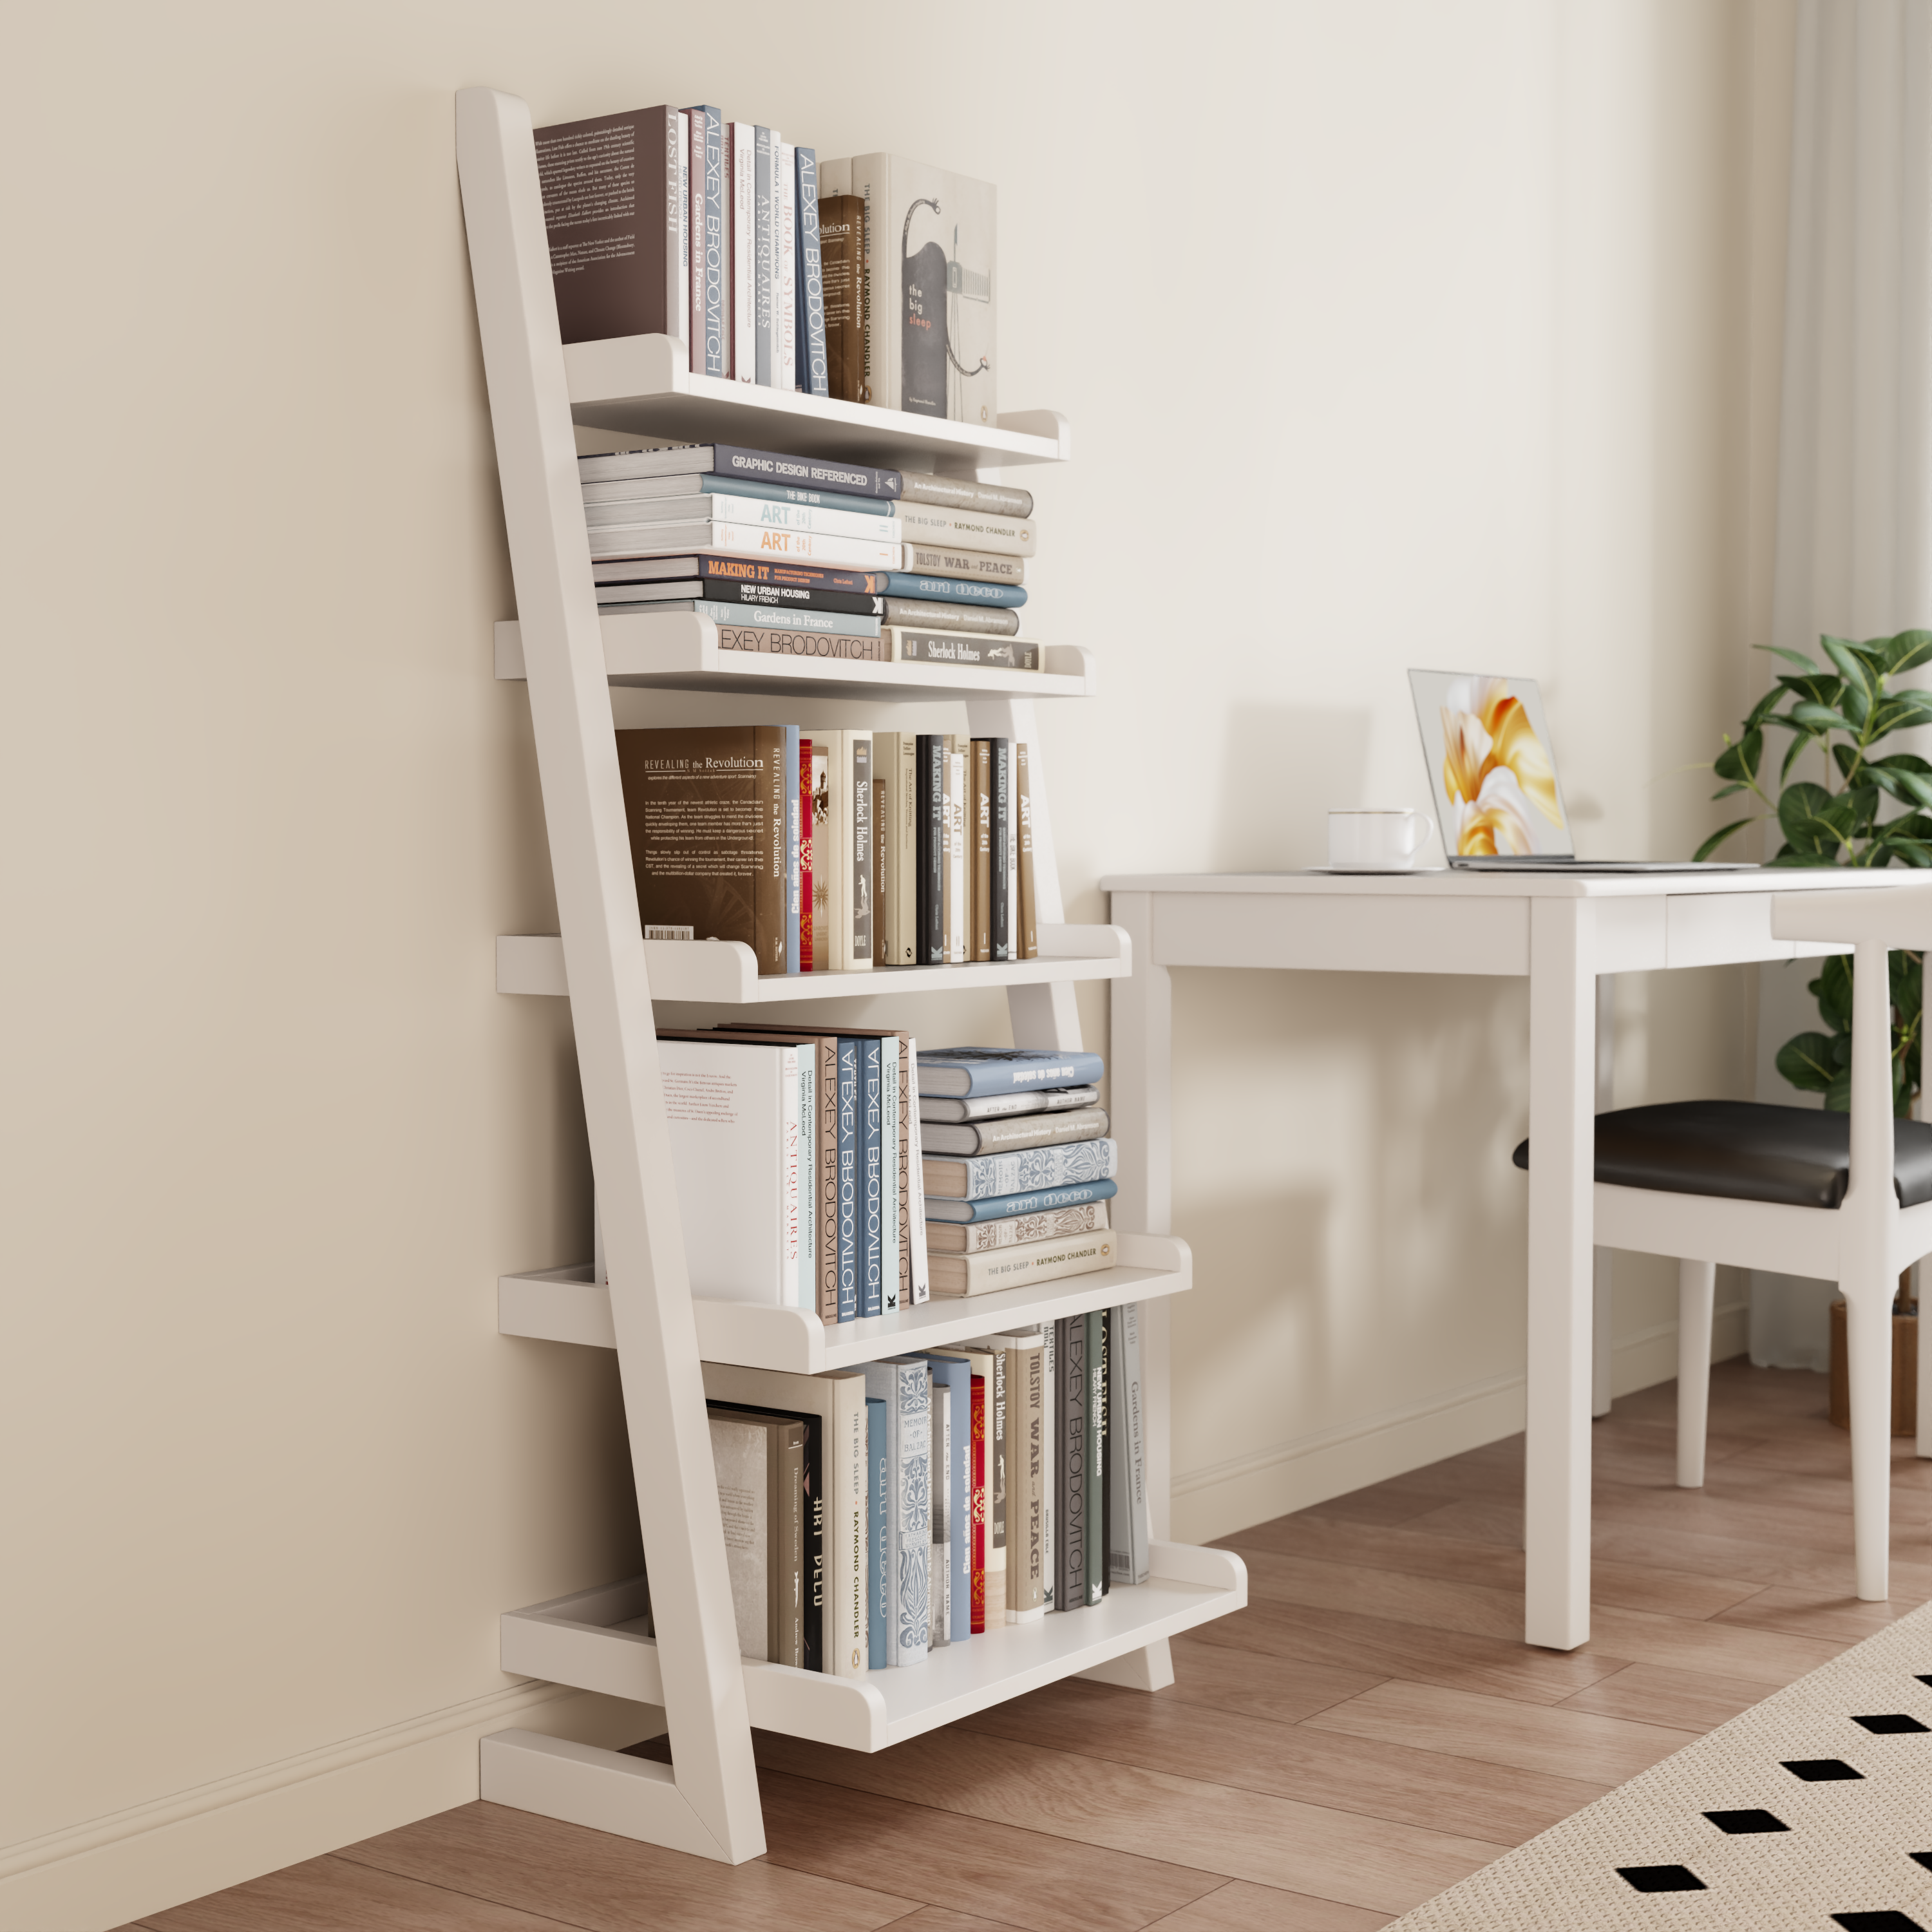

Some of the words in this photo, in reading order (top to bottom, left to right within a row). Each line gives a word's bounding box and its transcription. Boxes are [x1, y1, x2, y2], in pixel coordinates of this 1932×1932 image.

[668, 113, 677, 175] LOST
[706, 112, 720, 209] ALEXEY
[668, 178, 677, 232] FISH
[800, 153, 819, 242] ALEXEY
[695, 193, 703, 247] Gardens
[784, 205, 793, 256] BOOK
[696, 249, 703, 263] in
[760, 194, 770, 328] ANTIQUAIRES
[784, 260, 788, 272] OF
[706, 214, 721, 372] BRODOVITCH
[909, 284, 923, 298] the
[909, 298, 923, 315] big
[784, 276, 793, 367] SYMBOLS
[805, 248, 827, 391] BRODOVITCH
[909, 313, 931, 331] sleep
[732, 455, 773, 472] GRAPHIC
[775, 462, 809, 478] DESIGN
[811, 468, 867, 486] REFERENCED
[786, 490, 796, 500] THE
[797, 492, 808, 502] BIKE
[808, 493, 820, 504] BOOK
[922, 484, 956, 495] Architectural
[956, 488, 974, 498] History
[978, 492, 992, 500] Daniel
[761, 504, 791, 525] ART
[905, 515, 916, 524] THE
[918, 517, 928, 526] BIG
[930, 518, 947, 527] SLEEP
[954, 522, 984, 533] RAYMOND
[986, 526, 1016, 537] CHANDLER
[761, 531, 791, 552] ART
[708, 560, 755, 580] MAKING
[757, 565, 770, 580] IT
[741, 584, 756, 594] NEW
[757, 585, 780, 597] URBAN
[781, 588, 810, 600] HOUSING
[741, 593, 758, 602] HILARY
[759, 594, 779, 604] FRENCH
[920, 580, 951, 594] art
[956, 583, 1003, 599] deco
[753, 610, 791, 625] Gardens
[792, 612, 802, 625] in
[803, 615, 833, 629] France
[719, 629, 764, 651] EXEY
[770, 633, 873, 659] BRODOVITCH
[928, 640, 956, 659] Sherlock
[957, 643, 980, 661] Holmes
[1024, 651, 1032, 668] DOYLE
[645, 759, 689, 770] REVEALING
[705, 756, 764, 768] Revolution
[933, 745, 942, 802] MAKING
[998, 747, 1007, 804] MAKING
[857, 781, 868, 823] Sherlock
[980, 793, 990, 828] ART
[1021, 794, 1030, 828] ART
[933, 806, 942, 821] IT
[954, 804, 962, 835] ART
[998, 806, 1007, 821] IT
[791, 844, 799, 858] de
[857, 826, 868, 862] Holmes
[855, 935, 866, 947] DOYLE
[1013, 1070, 1037, 1084] soledad
[1037, 1069, 1046, 1081] de
[1046, 1067, 1060, 1079] años
[1061, 1066, 1074, 1078] Cien
[825, 1046, 836, 1139] ALEXEY
[789, 1121, 797, 1259] ANTIQUAIRES
[825, 1149, 836, 1306] BRODOVITCH
[988, 1266, 999, 1276] THE
[1001, 1264, 1011, 1273] BIG
[1013, 1261, 1029, 1271] SLEEP
[1036, 1254, 1066, 1266] RAYMOND
[1067, 1248, 1097, 1260] CHANDLER
[996, 1353, 1005, 1398] Sherlock
[1030, 1352, 1040, 1409] TOLSTOY
[1131, 1381, 1140, 1438] Gardens
[904, 1416, 927, 1428] MEMOIR
[996, 1401, 1005, 1441] Holmes
[904, 1440, 926, 1452] BALZAC
[1030, 1417, 1039, 1479] WAR
[1133, 1440, 1141, 1455] in
[963, 1495, 971, 1511] de
[1070, 1417, 1083, 1589] BRODOVITCH
[794, 1514, 799, 1524] of
[994, 1520, 1005, 1535] DOYLE
[1030, 1499, 1039, 1580] PEACE
